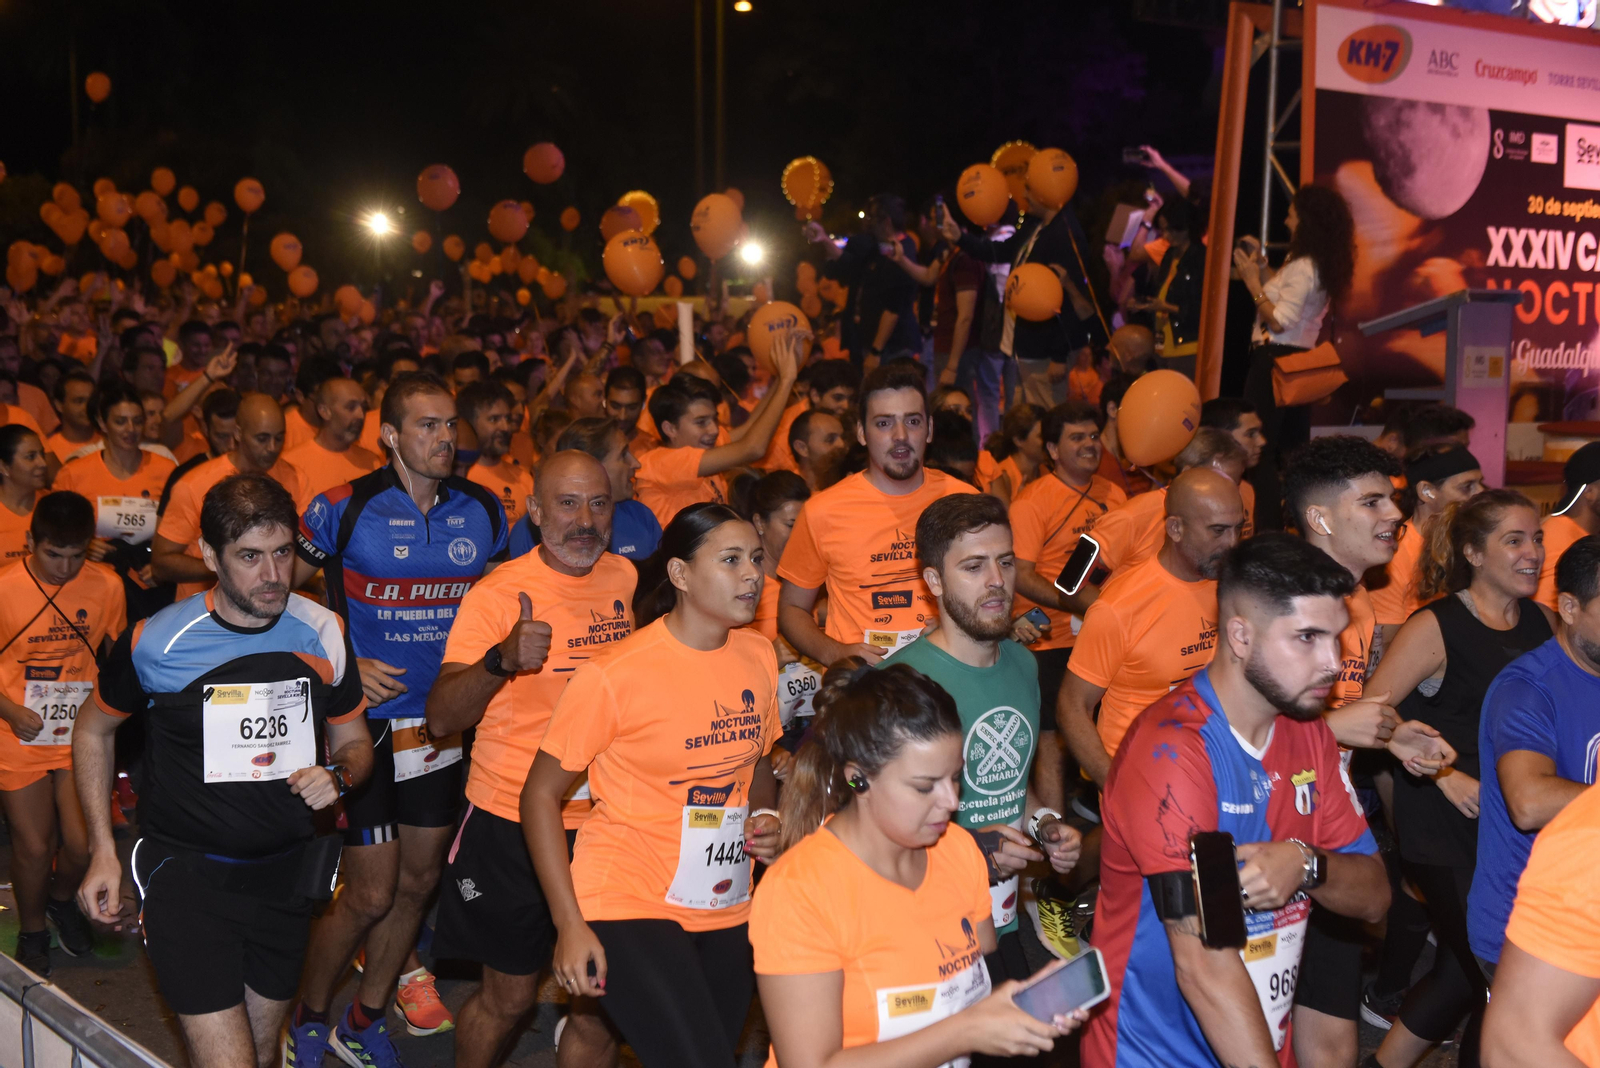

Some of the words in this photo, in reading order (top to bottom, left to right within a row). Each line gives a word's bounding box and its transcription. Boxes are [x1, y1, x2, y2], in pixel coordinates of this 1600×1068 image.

[1427, 49, 1460, 71] ABC
[1475, 58, 1539, 85] Cruzcampo
[1527, 195, 1544, 214] 30
[1545, 196, 1561, 216] de
[1486, 226, 1576, 270] XXXIV
[116, 513, 146, 527] 7565
[388, 519, 416, 527] LORENTE
[870, 551, 913, 563] SEVILLA
[365, 582, 404, 600] C.A.
[377, 609, 392, 621] LA
[395, 609, 435, 621] PUEBLA
[437, 608, 454, 619] DEL
[588, 620, 630, 634] NOCTURNA
[384, 632, 411, 642] LAS
[567, 633, 612, 648] SEVILLA
[787, 675, 816, 696] 6360
[41, 704, 77, 720] 1250
[240, 714, 288, 740] 6236
[711, 713, 761, 731] NOCTURNA
[685, 730, 737, 750] SEVILLA
[975, 768, 1020, 785] PRIMARIA
[958, 796, 999, 811] Escuela
[970, 812, 985, 823] de
